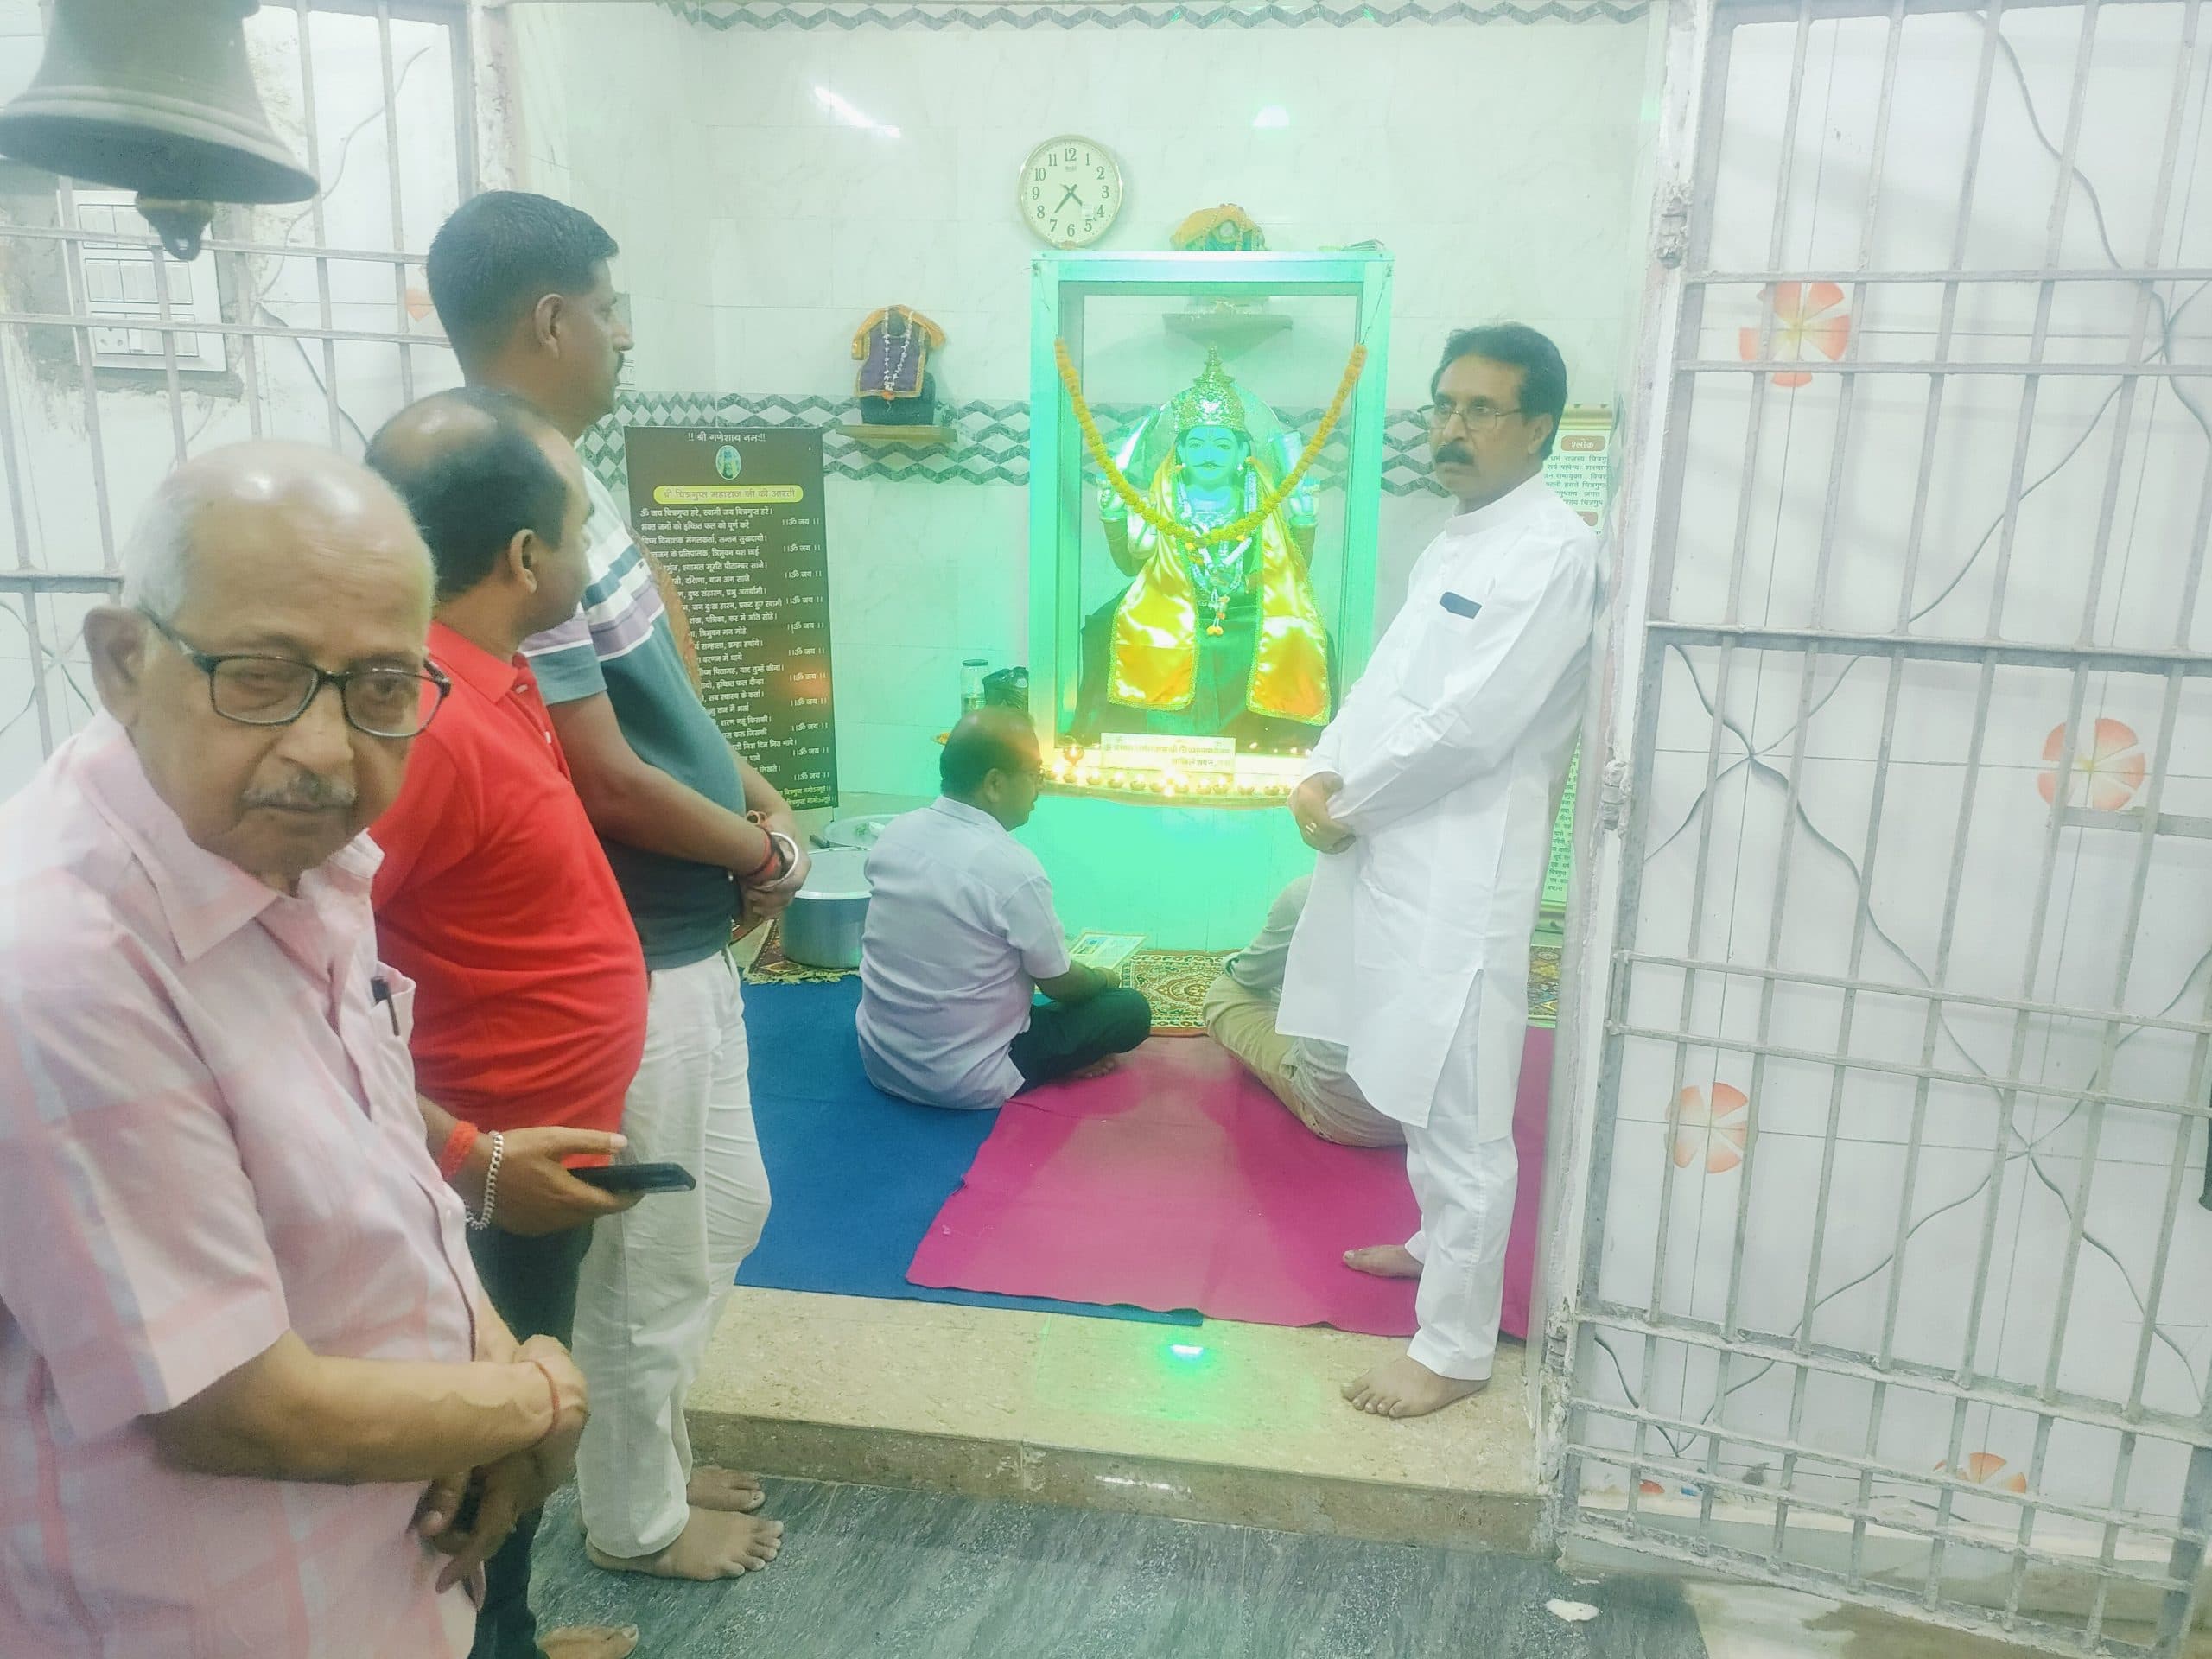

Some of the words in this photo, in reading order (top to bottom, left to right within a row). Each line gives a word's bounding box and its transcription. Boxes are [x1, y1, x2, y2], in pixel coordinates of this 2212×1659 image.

[1048, 154, 1058, 166] 11
[1065, 148, 1077, 161] 12
[1086, 153, 1090, 166] 1
[1034, 168, 1046, 181] 10
[1096, 166, 1104, 180] 2
[1032, 187, 1040, 200] 9
[1102, 186, 1109, 199] 3
[1037, 205, 1045, 219] 8
[1097, 205, 1104, 218] 4
[1050, 219, 1058, 232] 7
[1067, 224, 1075, 237] 6
[1084, 219, 1092, 232] 5
[709, 432, 741, 442] गणेशाय
[1571, 439, 1596, 449] श्लोक
[677, 489, 707, 501] चित्रगुप्त
[710, 490, 742, 499] महाराज
[772, 487, 796, 498] आरती
